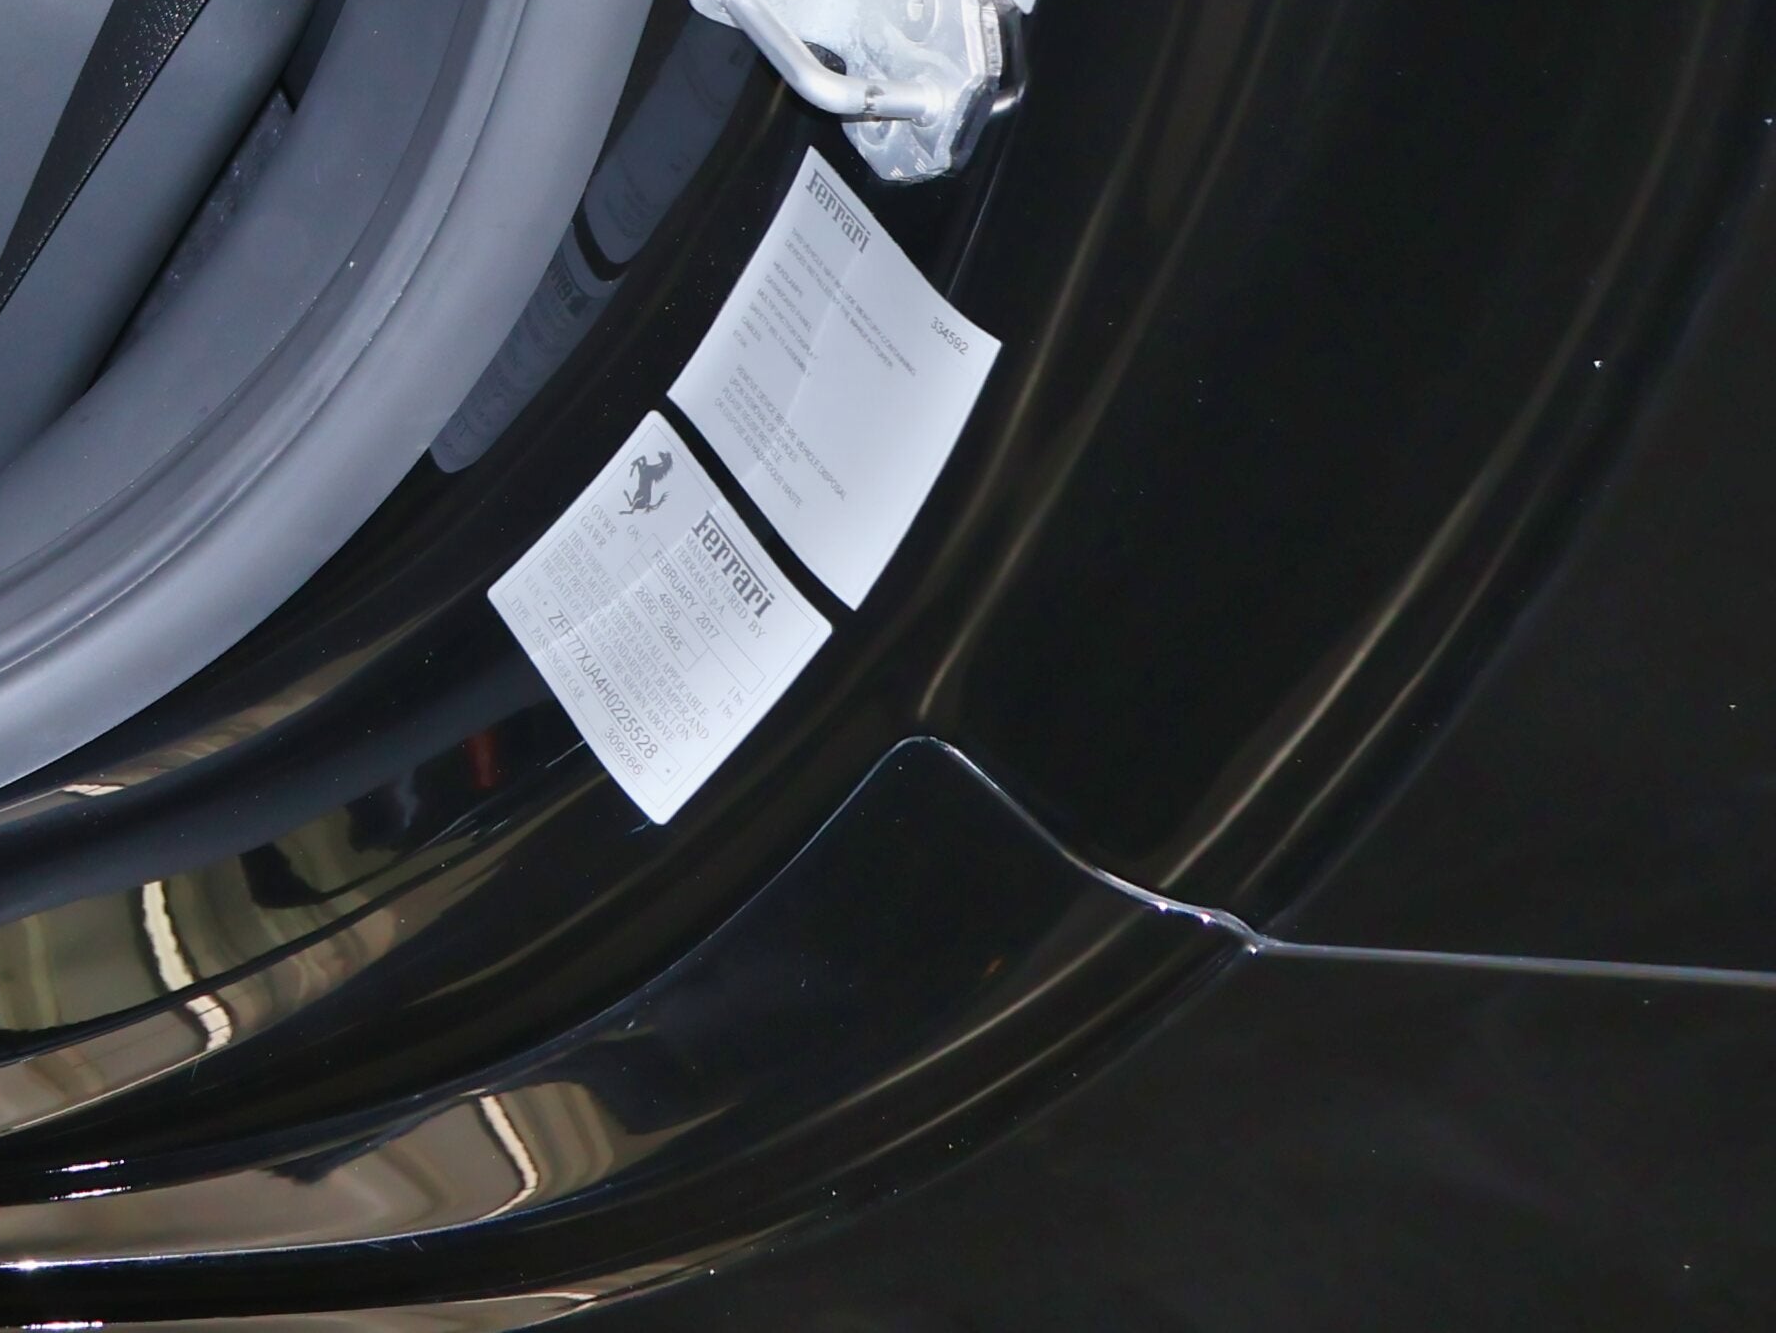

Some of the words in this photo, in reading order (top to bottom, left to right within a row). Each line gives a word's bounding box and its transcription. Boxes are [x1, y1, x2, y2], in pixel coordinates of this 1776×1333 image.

[803, 168, 874, 255] Ferrari
[928, 314, 970, 357] 334592
[578, 513, 607, 550] GAWR
[633, 584, 658, 617] 2050
[658, 619, 684, 653] 2845
[588, 501, 618, 538] GVWR
[656, 589, 682, 623] 4850
[625, 521, 642, 543] ON
[672, 544, 709, 591] FERRARI
[681, 533, 750, 622] MANUFACTURED
[746, 618, 765, 641] BY
[690, 509, 777, 620] Ferrari
[548, 547, 573, 580] THEFT
[567, 573, 610, 631] PREVENTION
[604, 625, 645, 682] STANDARDS
[639, 675, 653, 692] IN
[647, 685, 679, 727] EFFECT
[673, 720, 692, 743] ON
[567, 529, 587, 554] THIS
[581, 548, 612, 588] VEHICLE
[639, 628, 654, 647] TO
[647, 640, 666, 665] ALL
[660, 658, 709, 721] APPLICABLE
[606, 605, 638, 647] VEHICLE
[650, 548, 698, 611] FEBRUARY
[694, 610, 720, 642] 2017
[509, 596, 531, 624] TYPE
[565, 676, 586, 702] CAR
[602, 725, 644, 778] 309266
[546, 606, 660, 762] ZFF77XJA4H0225528
[567, 596, 583, 615] OF
[620, 670, 650, 710] SHOWN
[644, 703, 676, 745] ABOVE
